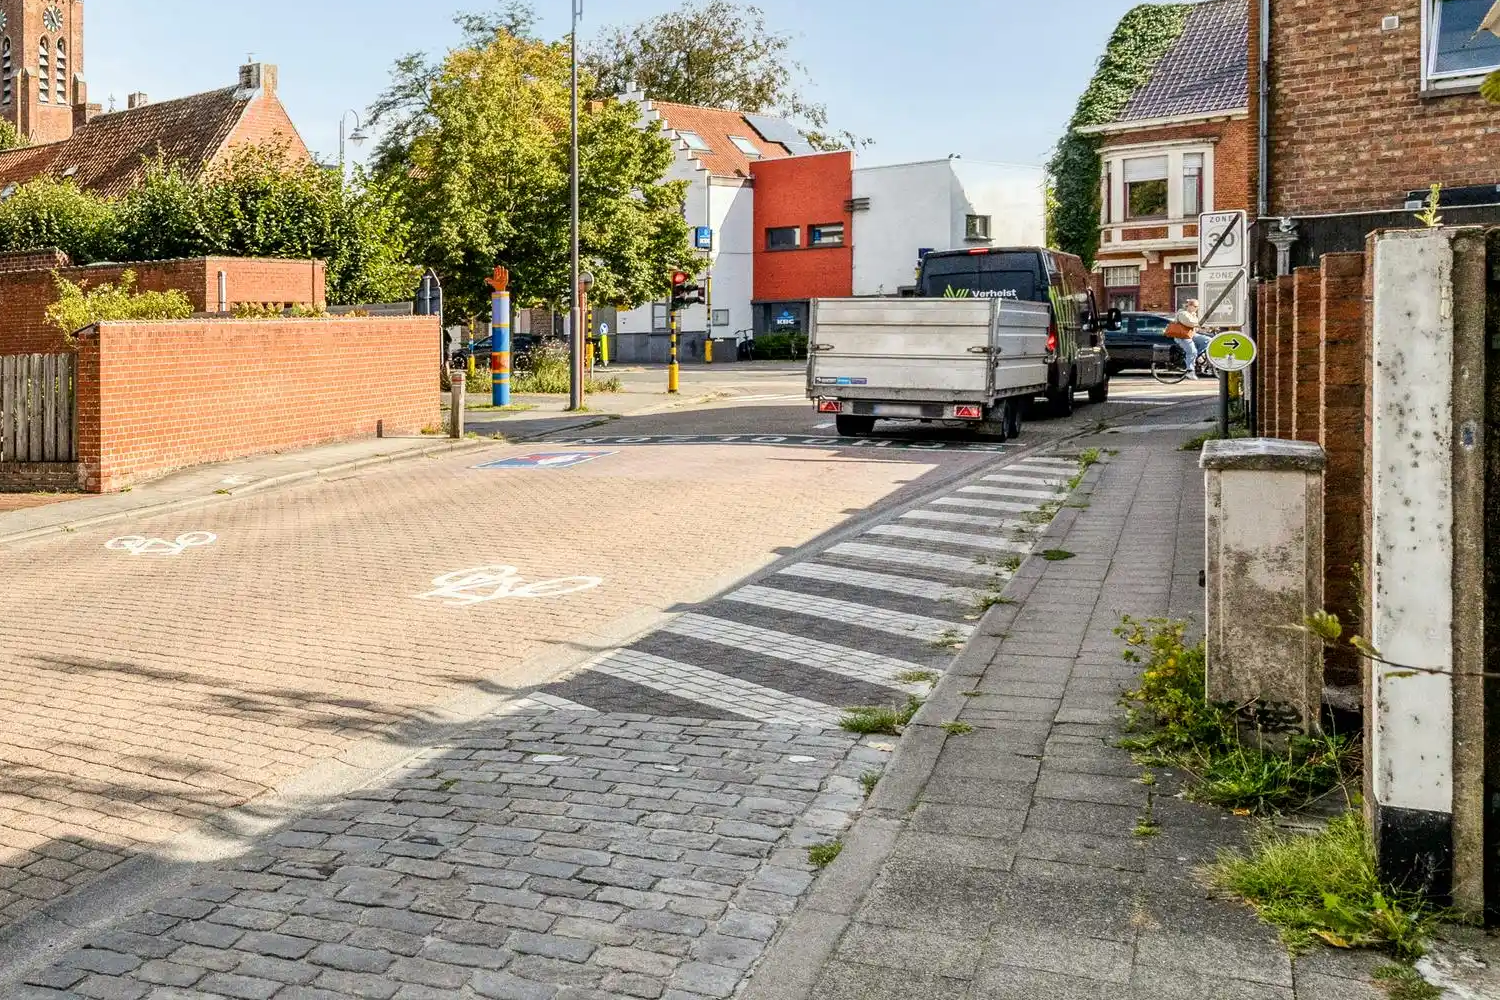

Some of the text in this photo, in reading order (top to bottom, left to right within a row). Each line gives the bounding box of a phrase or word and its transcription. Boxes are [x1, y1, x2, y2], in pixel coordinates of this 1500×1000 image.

[1209, 215, 1232, 223] ZONE
[1208, 232, 1235, 248] 30
[1209, 271, 1233, 279] ZONE
